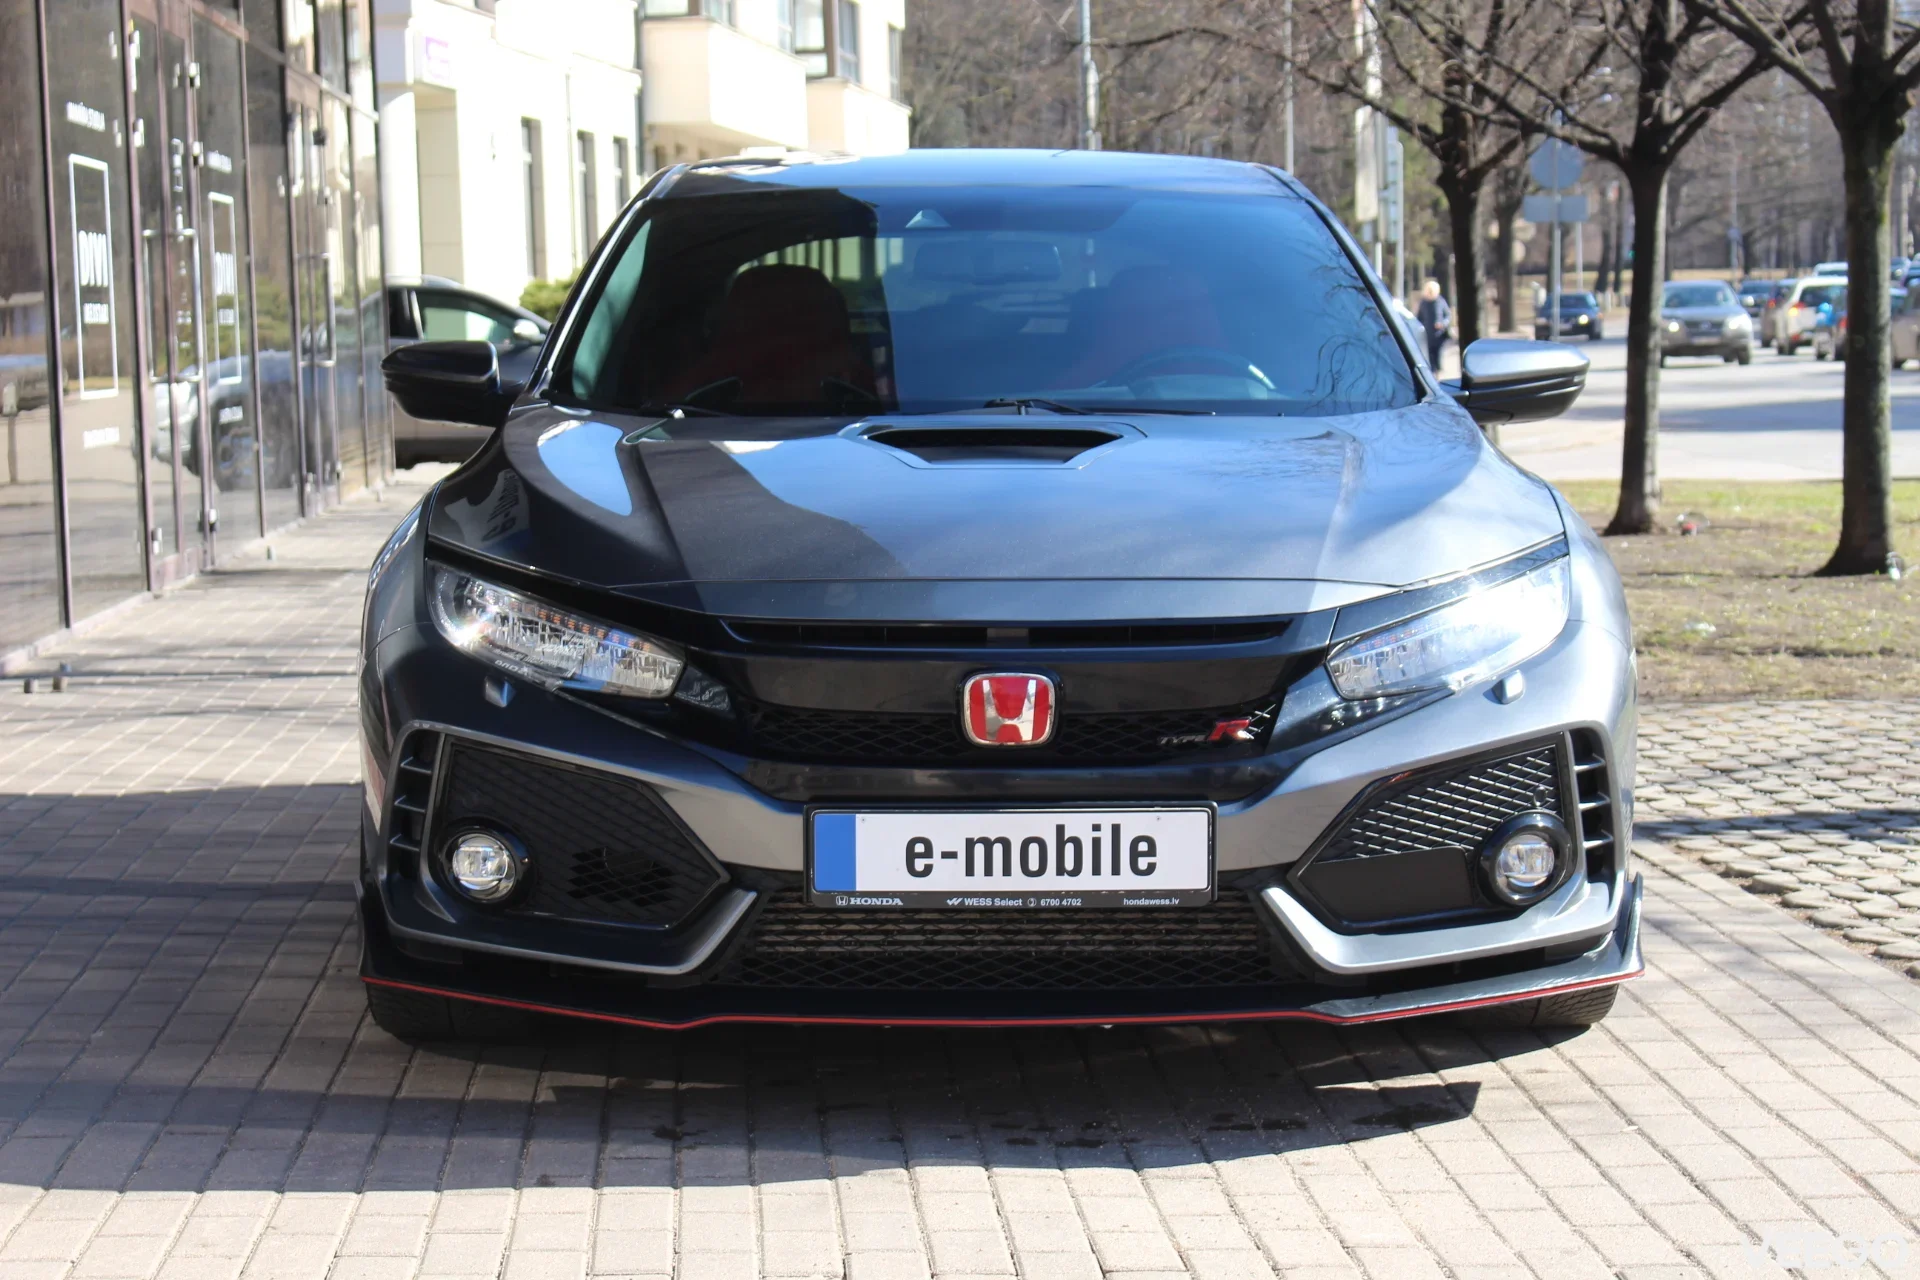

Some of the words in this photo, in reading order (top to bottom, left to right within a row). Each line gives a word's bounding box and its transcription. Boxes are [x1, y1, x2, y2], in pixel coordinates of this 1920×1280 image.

[1160, 735, 1207, 745] TYPE
[1208, 716, 1255, 741] R
[905, 824, 1158, 877] e-mobile
[850, 897, 903, 905] HONDA
[964, 897, 993, 906] WESS
[994, 897, 1023, 906] Select
[1040, 897, 1060, 906] 6700
[1061, 897, 1082, 906] 4702
[1123, 897, 1180, 906] hondawess.lv
